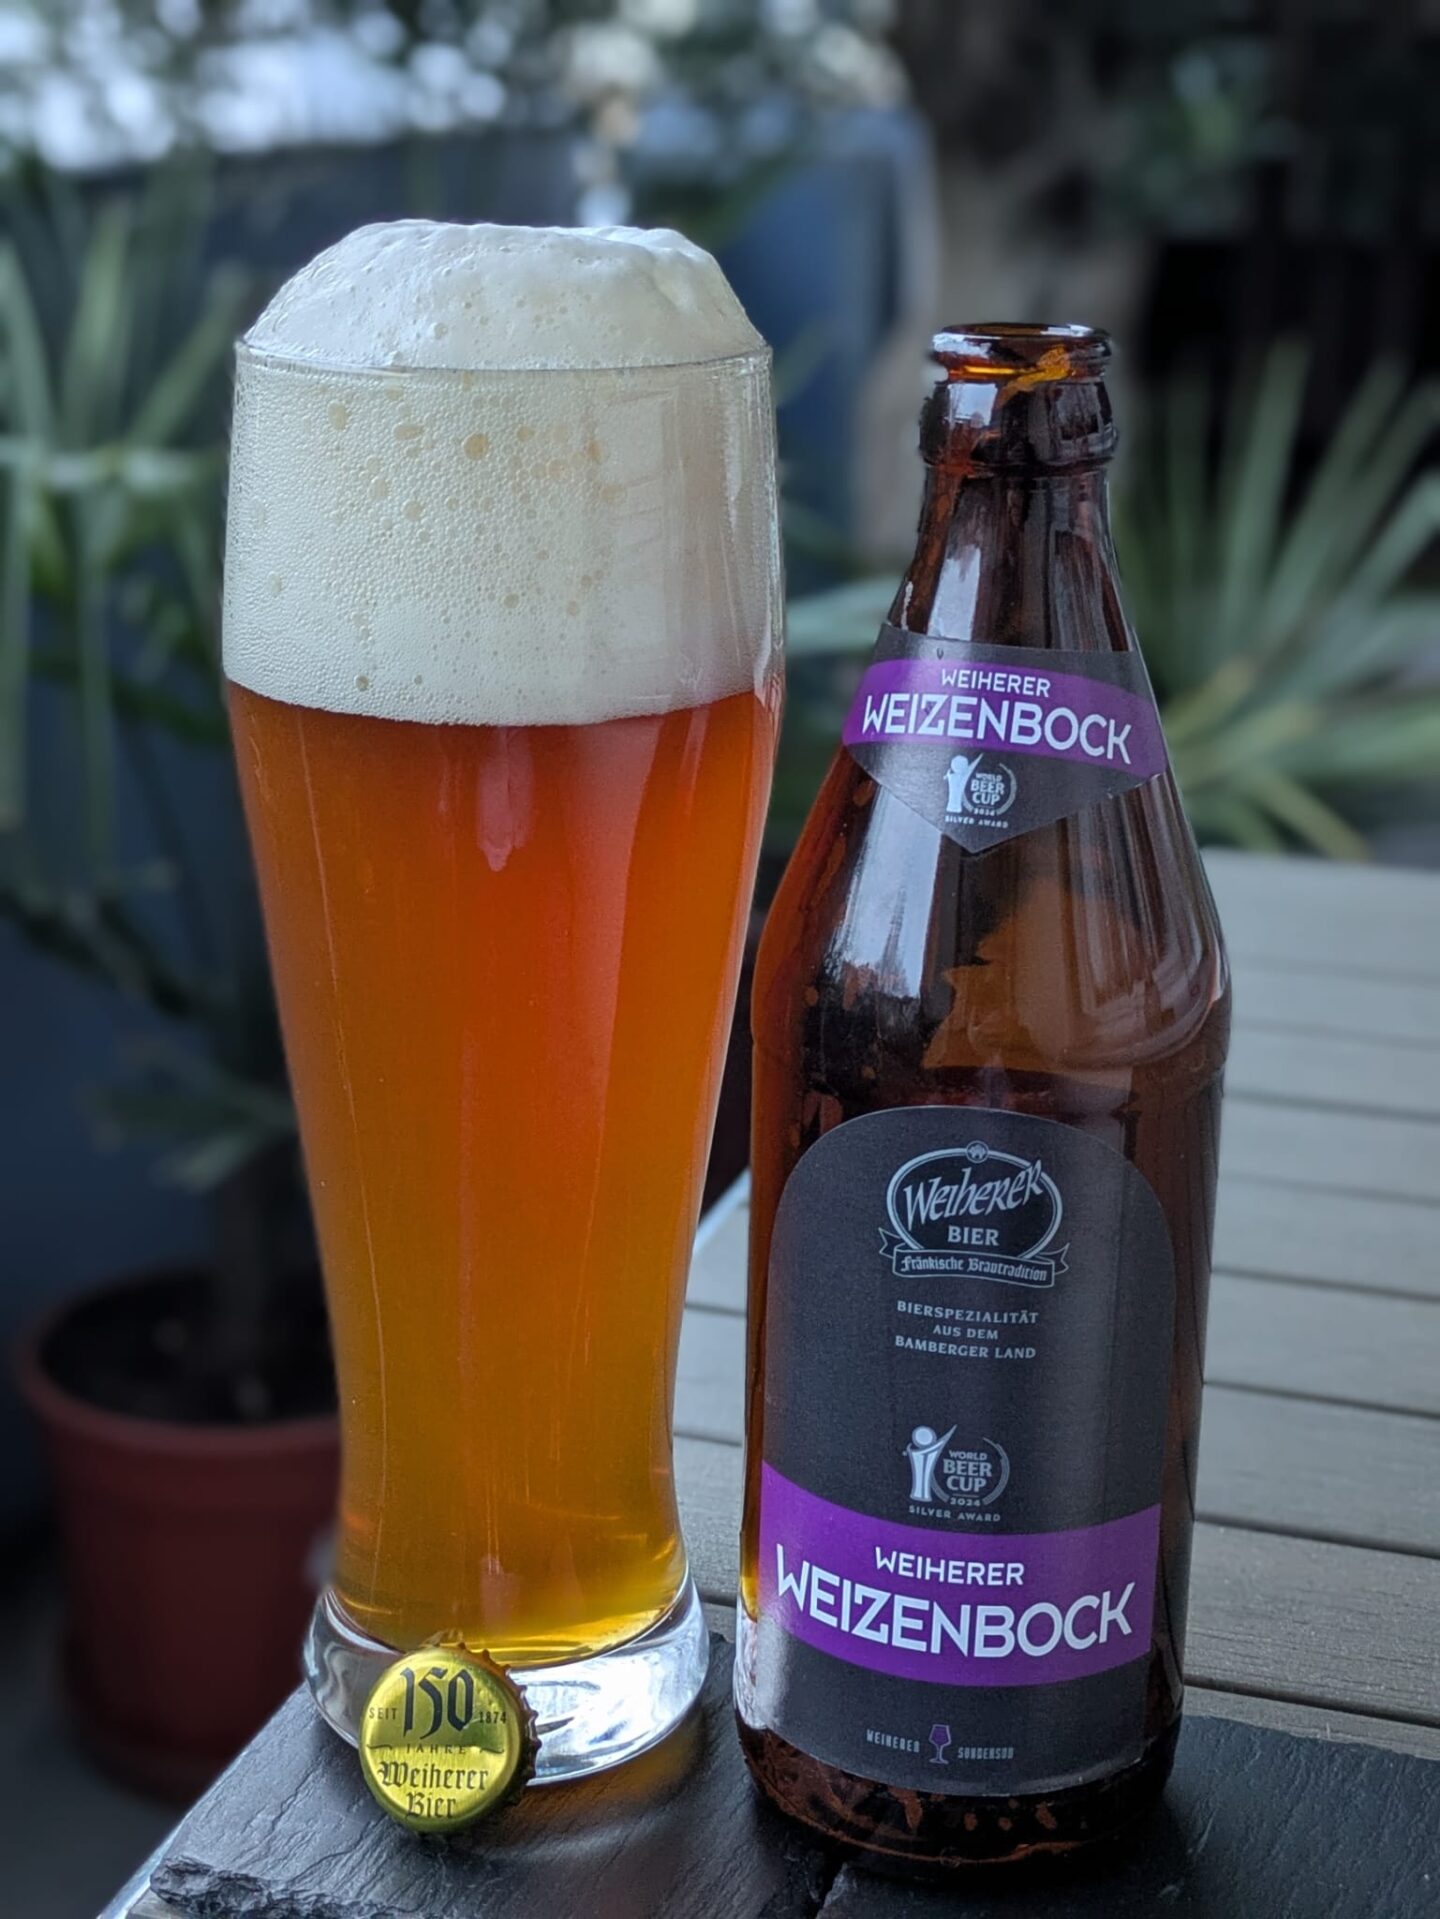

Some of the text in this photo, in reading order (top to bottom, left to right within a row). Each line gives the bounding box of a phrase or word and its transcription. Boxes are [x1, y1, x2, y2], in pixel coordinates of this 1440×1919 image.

[941, 668, 1051, 697] WEIHERER
[862, 692, 1132, 764] WEIZENBOCK
[970, 779, 1005, 795] BEER
[972, 792, 1000, 805] CUP
[978, 819, 1008, 828] AWARD
[947, 1225, 999, 1246] BIER
[901, 1256, 1048, 1281] Fränkische Brautradition
[897, 1300, 1039, 1324] BIERSPEZIALITÄT
[933, 1325, 998, 1340] AUS DEM
[895, 1335, 1037, 1359] BAMBERGER LAND
[949, 1451, 987, 1461] WORLD
[943, 1458, 992, 1477] BEER
[946, 1475, 987, 1492] CUP
[909, 1505, 1001, 1522] SILVER AWARD
[875, 1547, 1025, 1586] WEIHERER
[776, 1543, 1136, 1658] WEIZENBOCK
[368, 1707, 398, 1721] SEIT
[400, 1667, 474, 1740] 150
[479, 1711, 508, 1724] 1874
[377, 1760, 489, 1790] Weiherer
[405, 1791, 457, 1819] Bier
